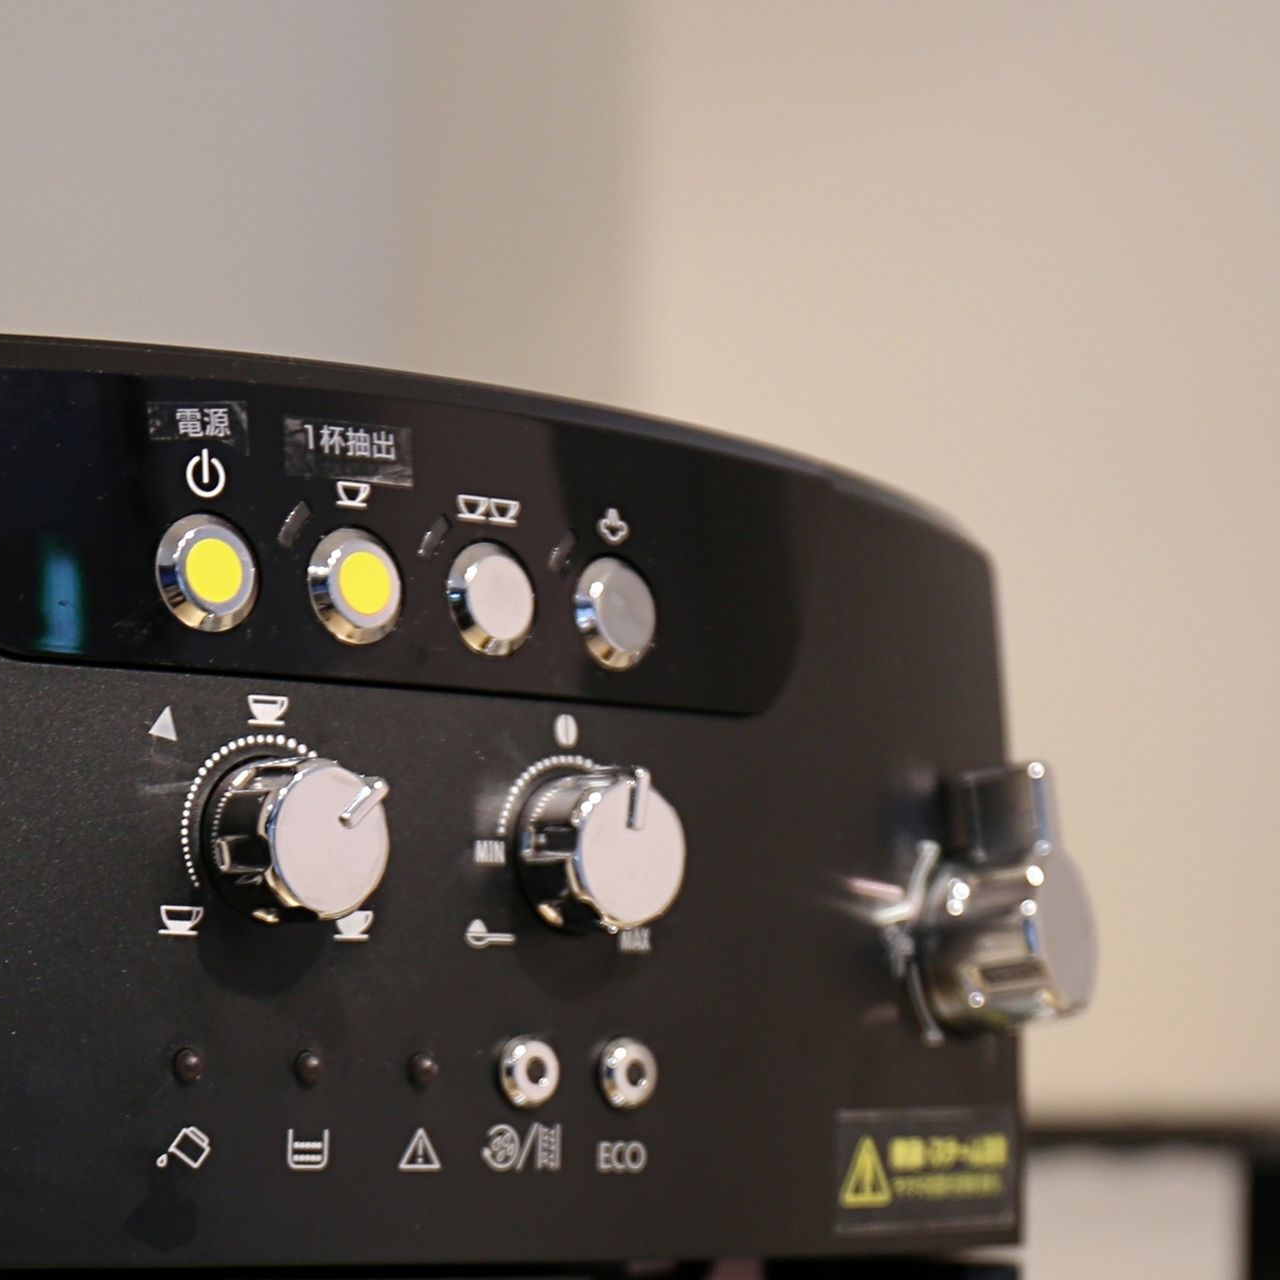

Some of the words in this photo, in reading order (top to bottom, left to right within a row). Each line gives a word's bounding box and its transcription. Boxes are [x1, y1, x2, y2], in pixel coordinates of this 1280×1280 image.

[175, 407, 231, 437] 電源
[302, 424, 397, 461] 1杯抽出
[474, 839, 505, 864] MIN
[619, 928, 652, 953] MAX
[596, 1140, 648, 1174] ECO
